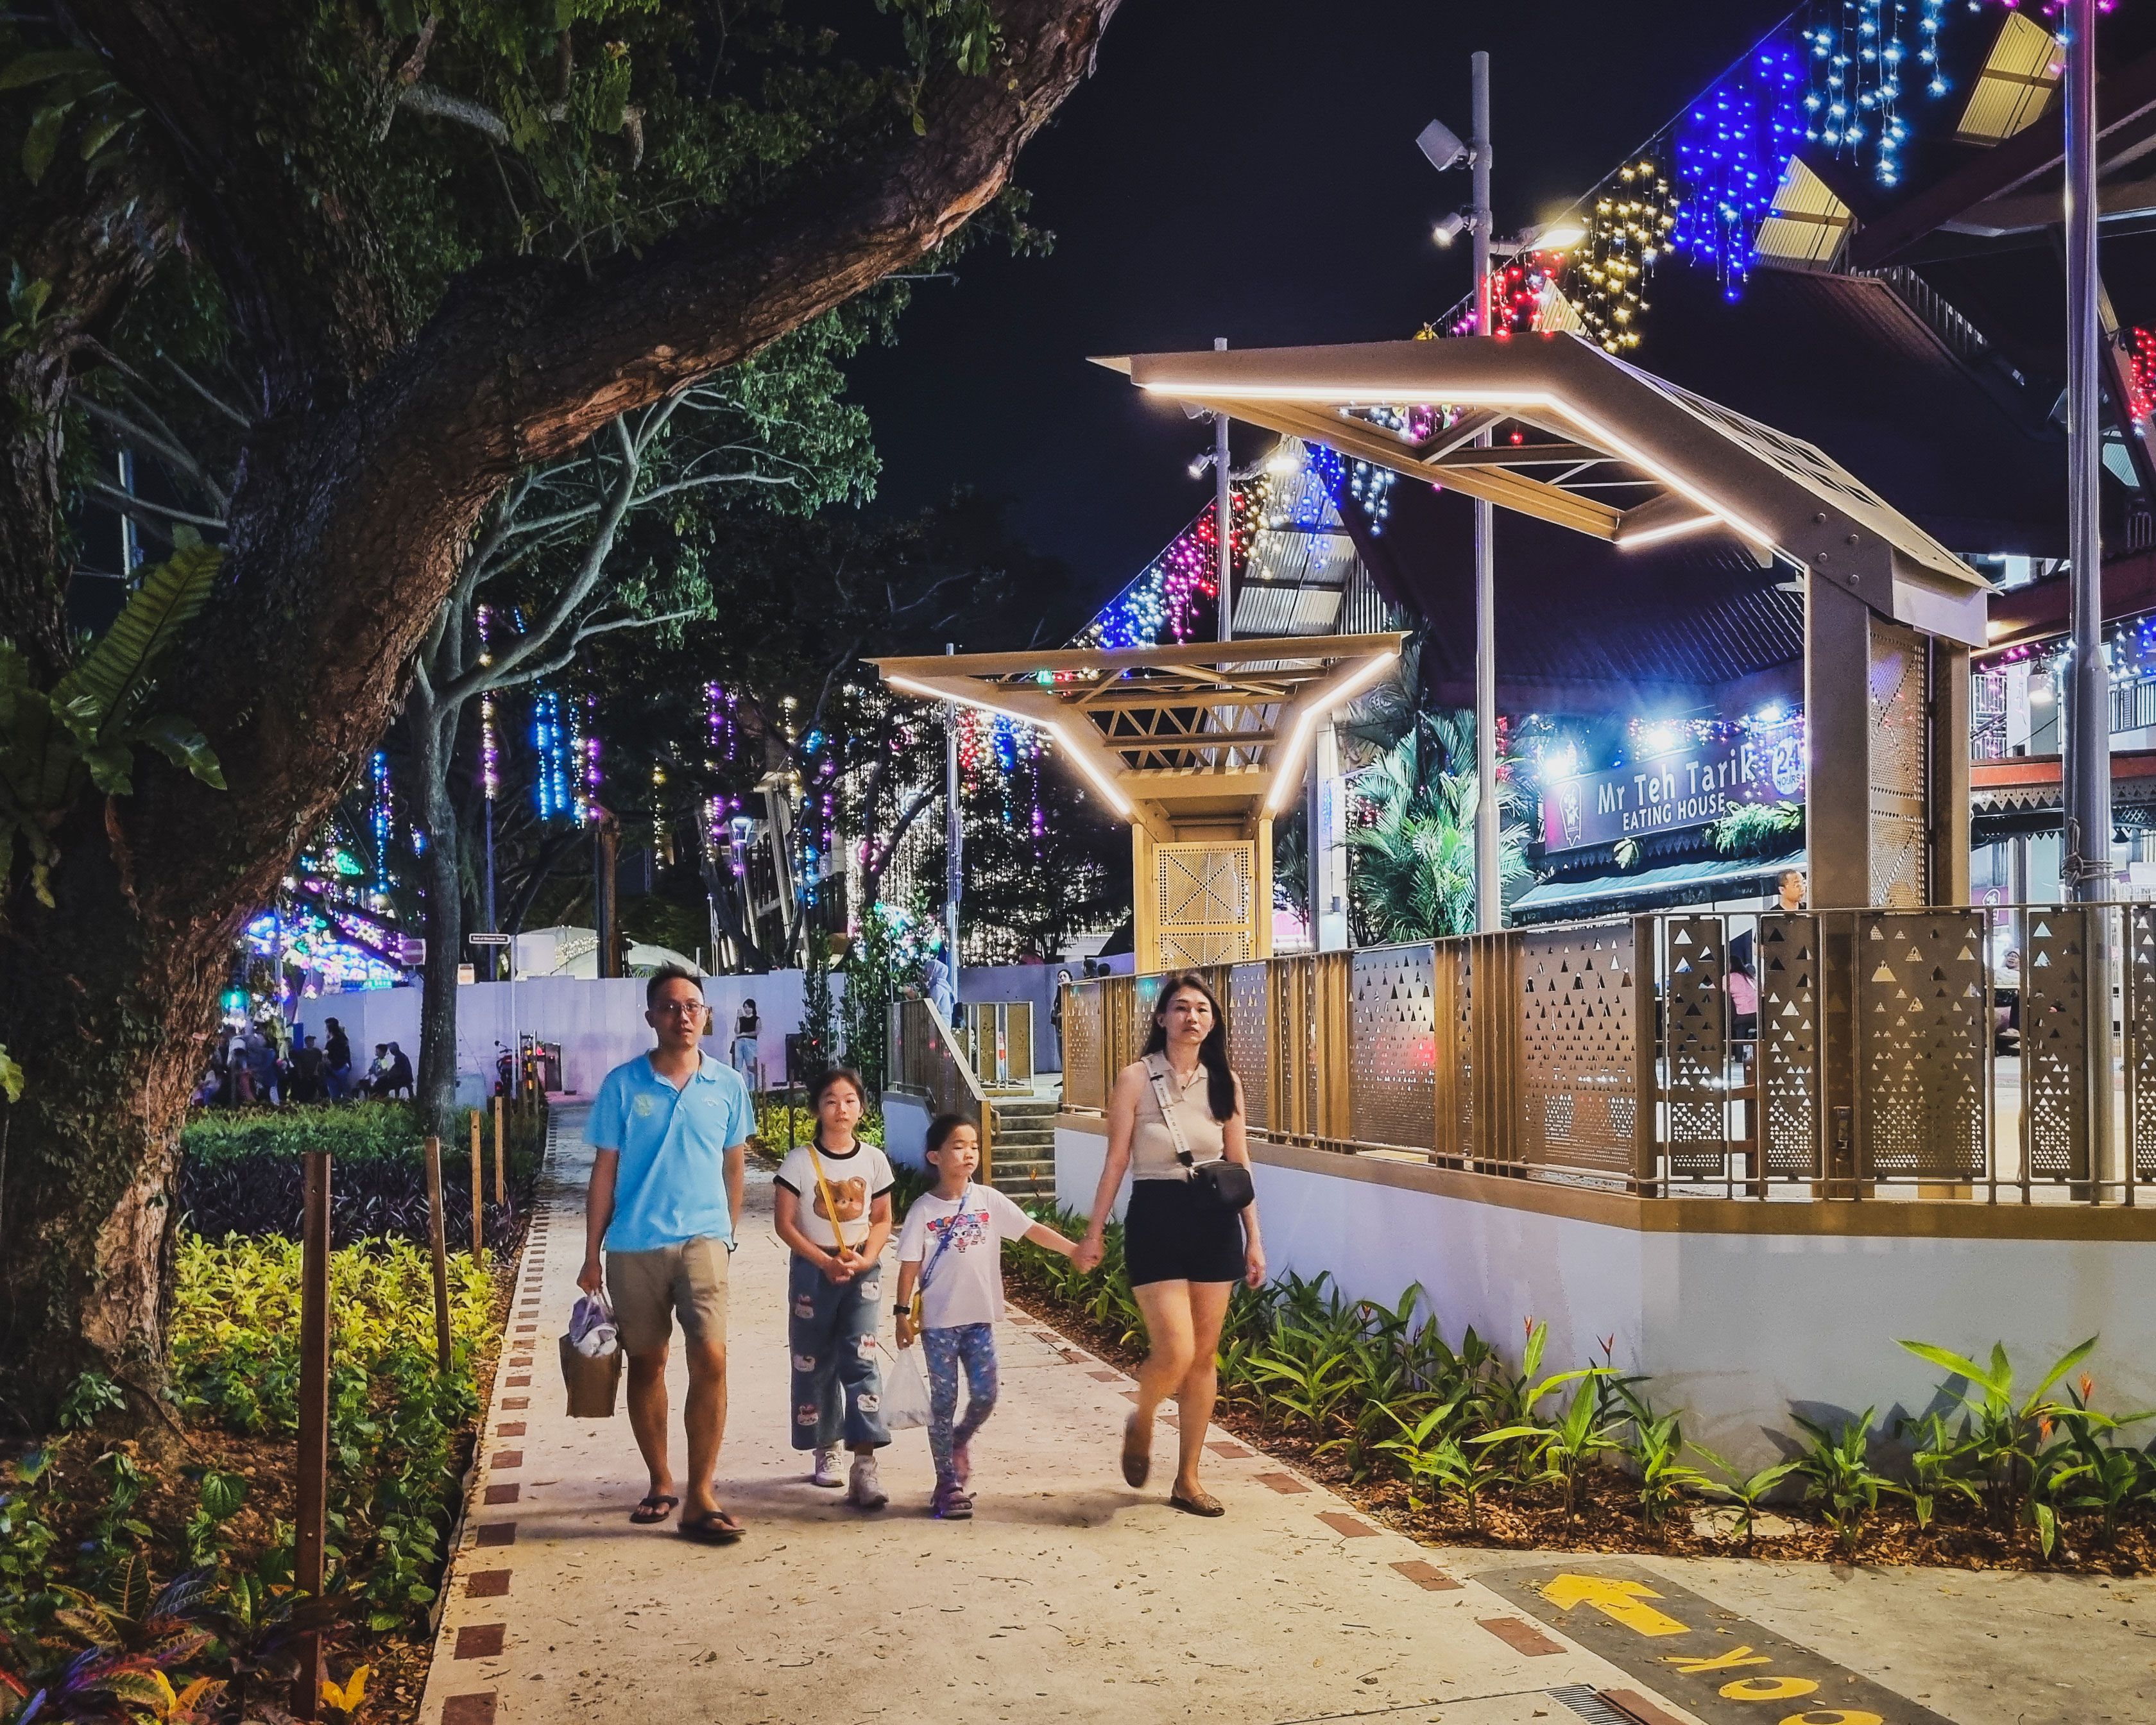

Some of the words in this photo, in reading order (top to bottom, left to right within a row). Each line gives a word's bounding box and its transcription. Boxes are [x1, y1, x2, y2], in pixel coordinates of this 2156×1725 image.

[1777, 743, 1800, 774] 24
[1598, 782, 1625, 815] Mr
[1634, 763, 1675, 806] Teh
[1686, 744, 1756, 794] Tarik
[1777, 773, 1801, 786] HOURS
[1623, 803, 1672, 831] EATING
[1677, 792, 1725, 821] HOUSE
